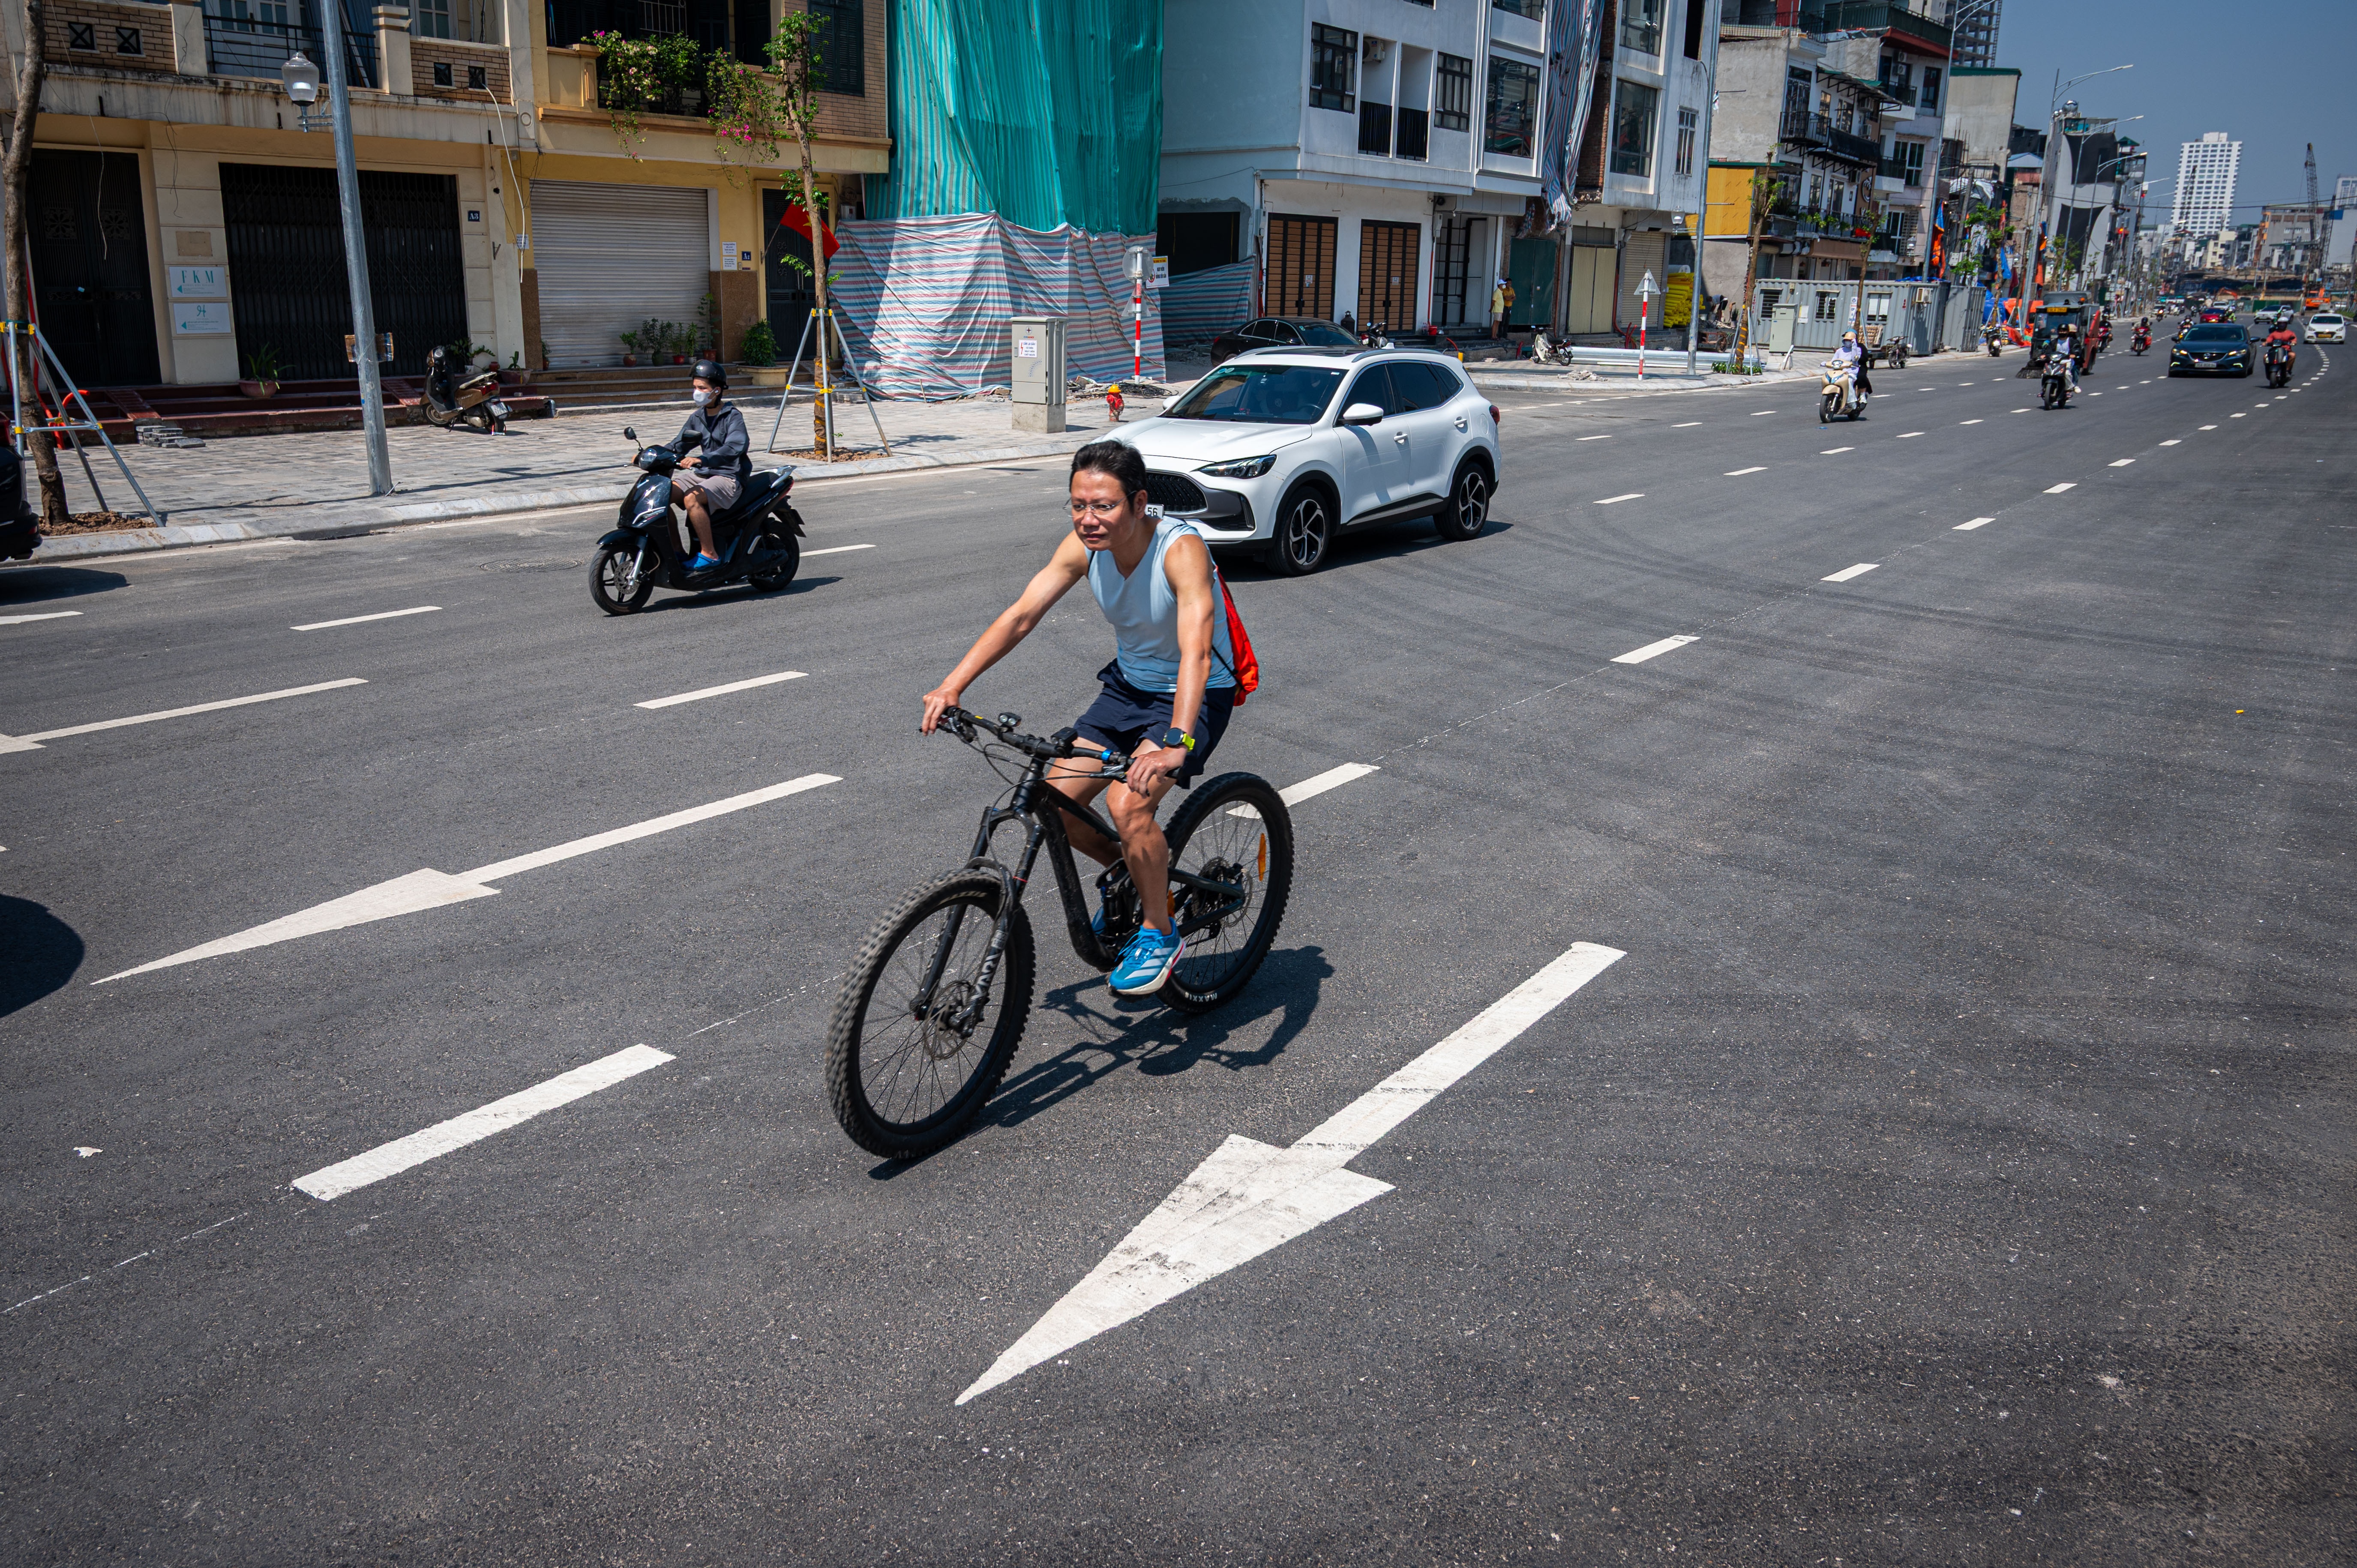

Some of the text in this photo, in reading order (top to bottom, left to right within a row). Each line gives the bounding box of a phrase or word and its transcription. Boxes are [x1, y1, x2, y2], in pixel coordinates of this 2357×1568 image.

[1148, 507, 1158, 516] 56
[970, 953, 1001, 1001] YARI
[1185, 992, 1217, 1002] MAXXIS
